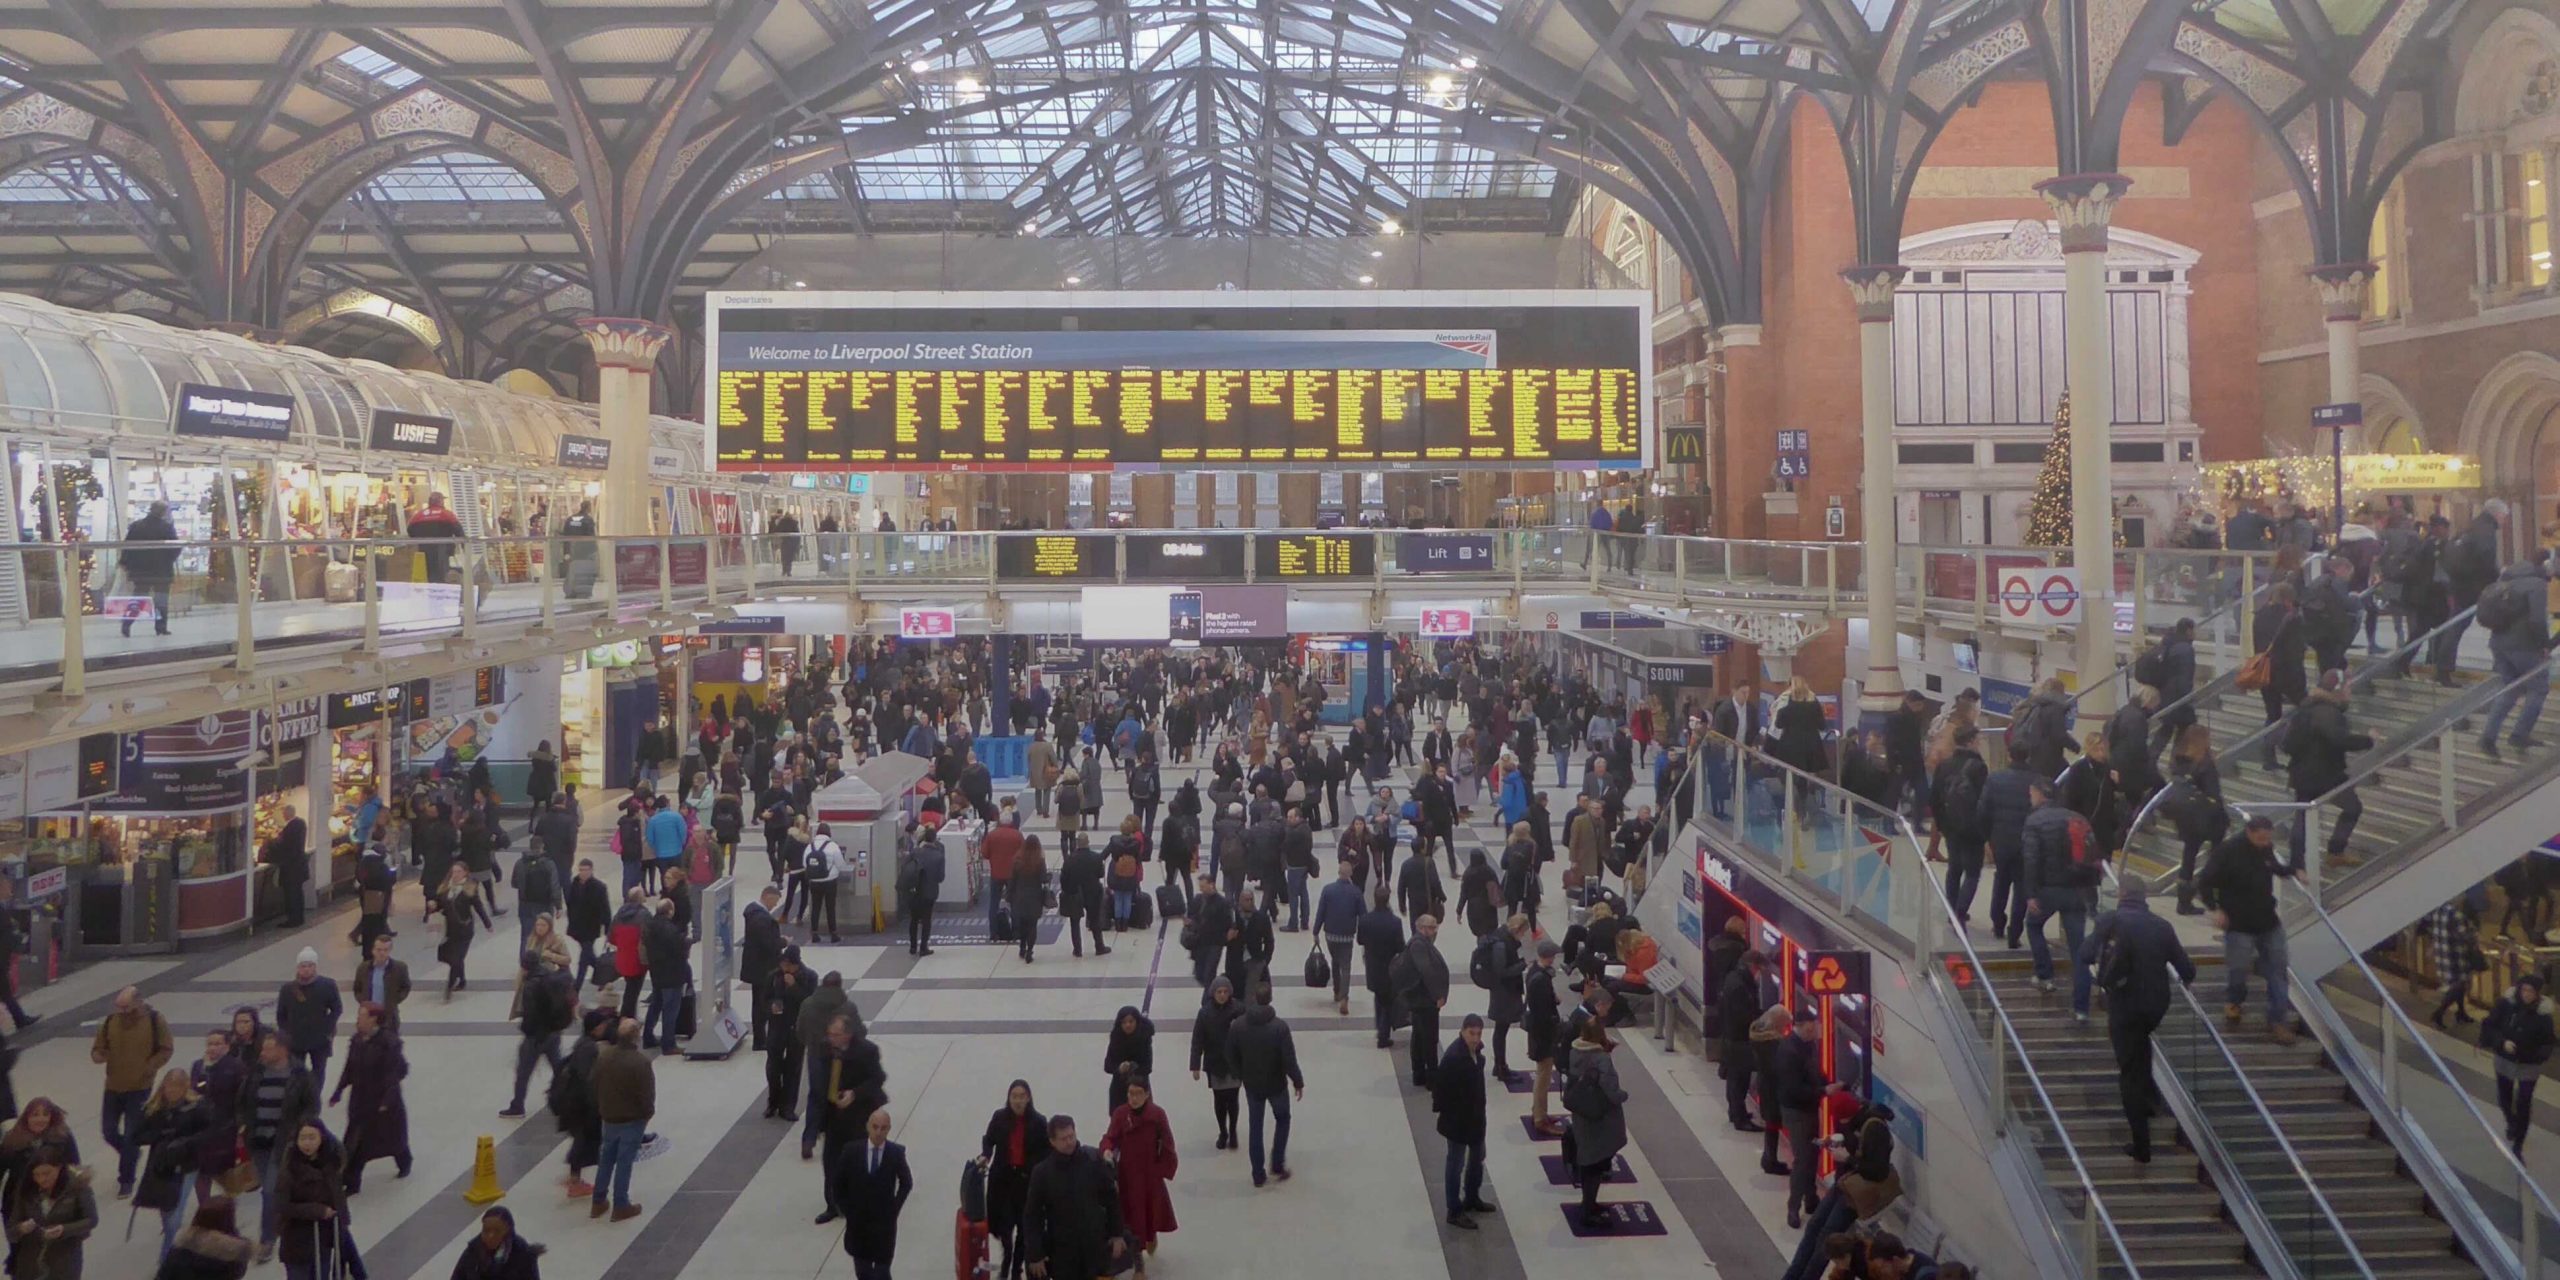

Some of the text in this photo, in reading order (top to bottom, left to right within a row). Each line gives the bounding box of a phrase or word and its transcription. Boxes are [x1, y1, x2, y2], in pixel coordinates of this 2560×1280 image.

[725, 295, 773, 305] Departures
[749, 343, 1034, 364] Welcome to Liverpool Street Station
[393, 423, 424, 443] LUSH
[951, 463, 969, 471] East
[1392, 461, 1411, 470] West
[1423, 547, 1448, 559] Lift
[1227, 612, 1241, 620] with
[1205, 619, 1257, 628] the highest rated
[1205, 627, 1225, 635] phone
[1650, 667, 1685, 682] SOON!
[125, 736, 139, 762] 5
